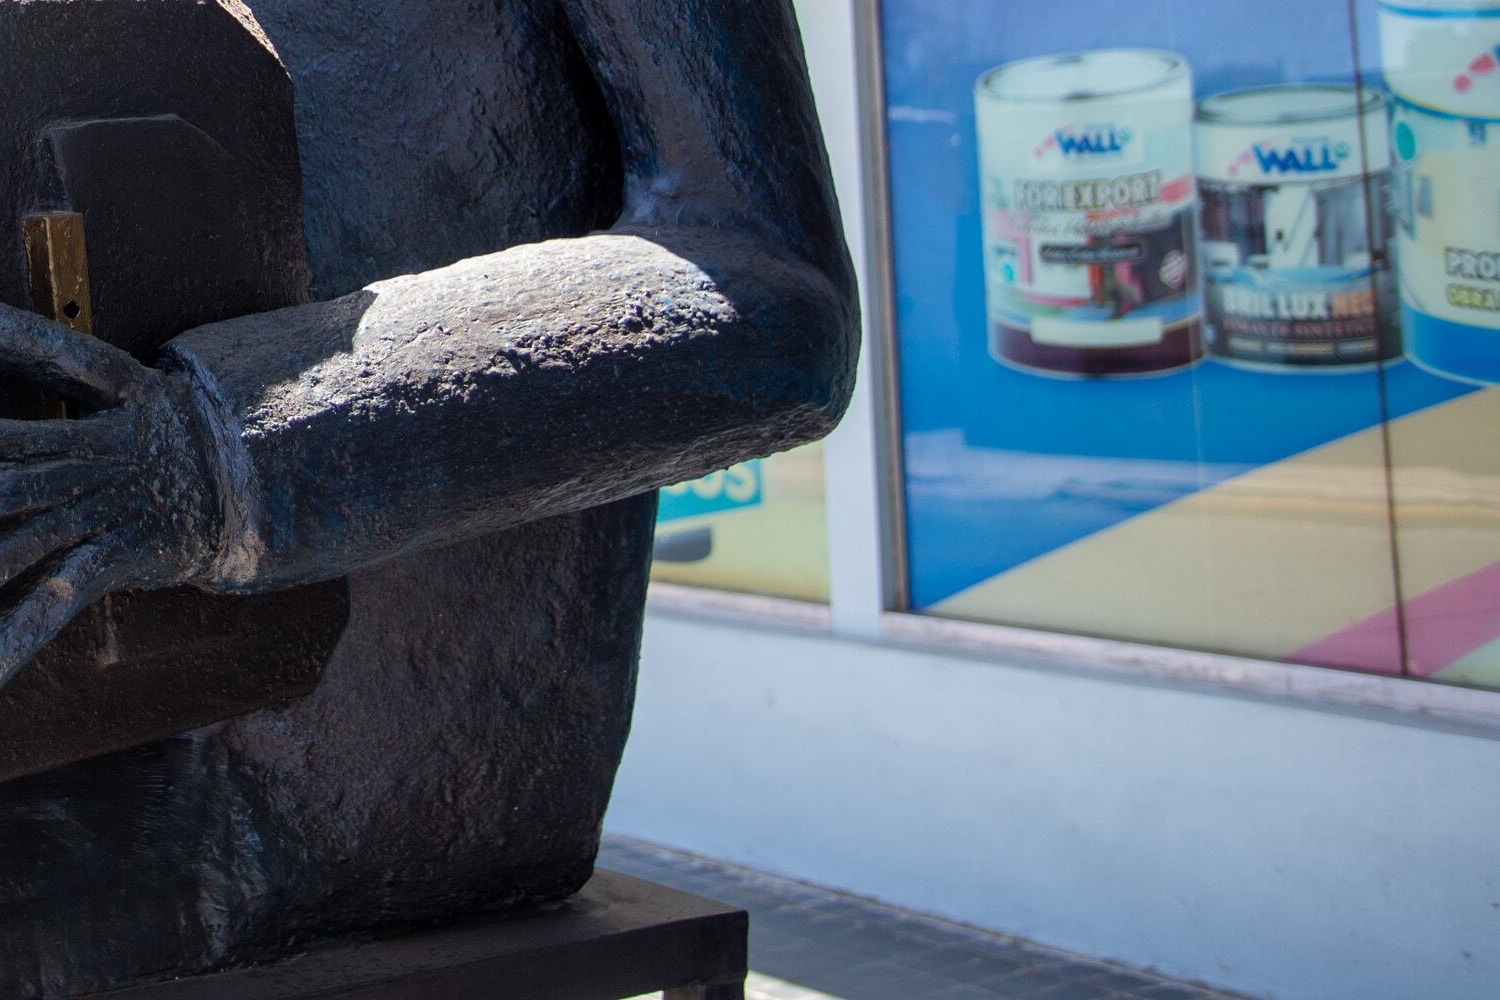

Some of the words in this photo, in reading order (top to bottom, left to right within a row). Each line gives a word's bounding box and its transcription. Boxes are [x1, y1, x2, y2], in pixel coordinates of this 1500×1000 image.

[1056, 130, 1121, 154] WALL
[1254, 145, 1337, 173] WALL
[1444, 247, 1500, 281] PRO
